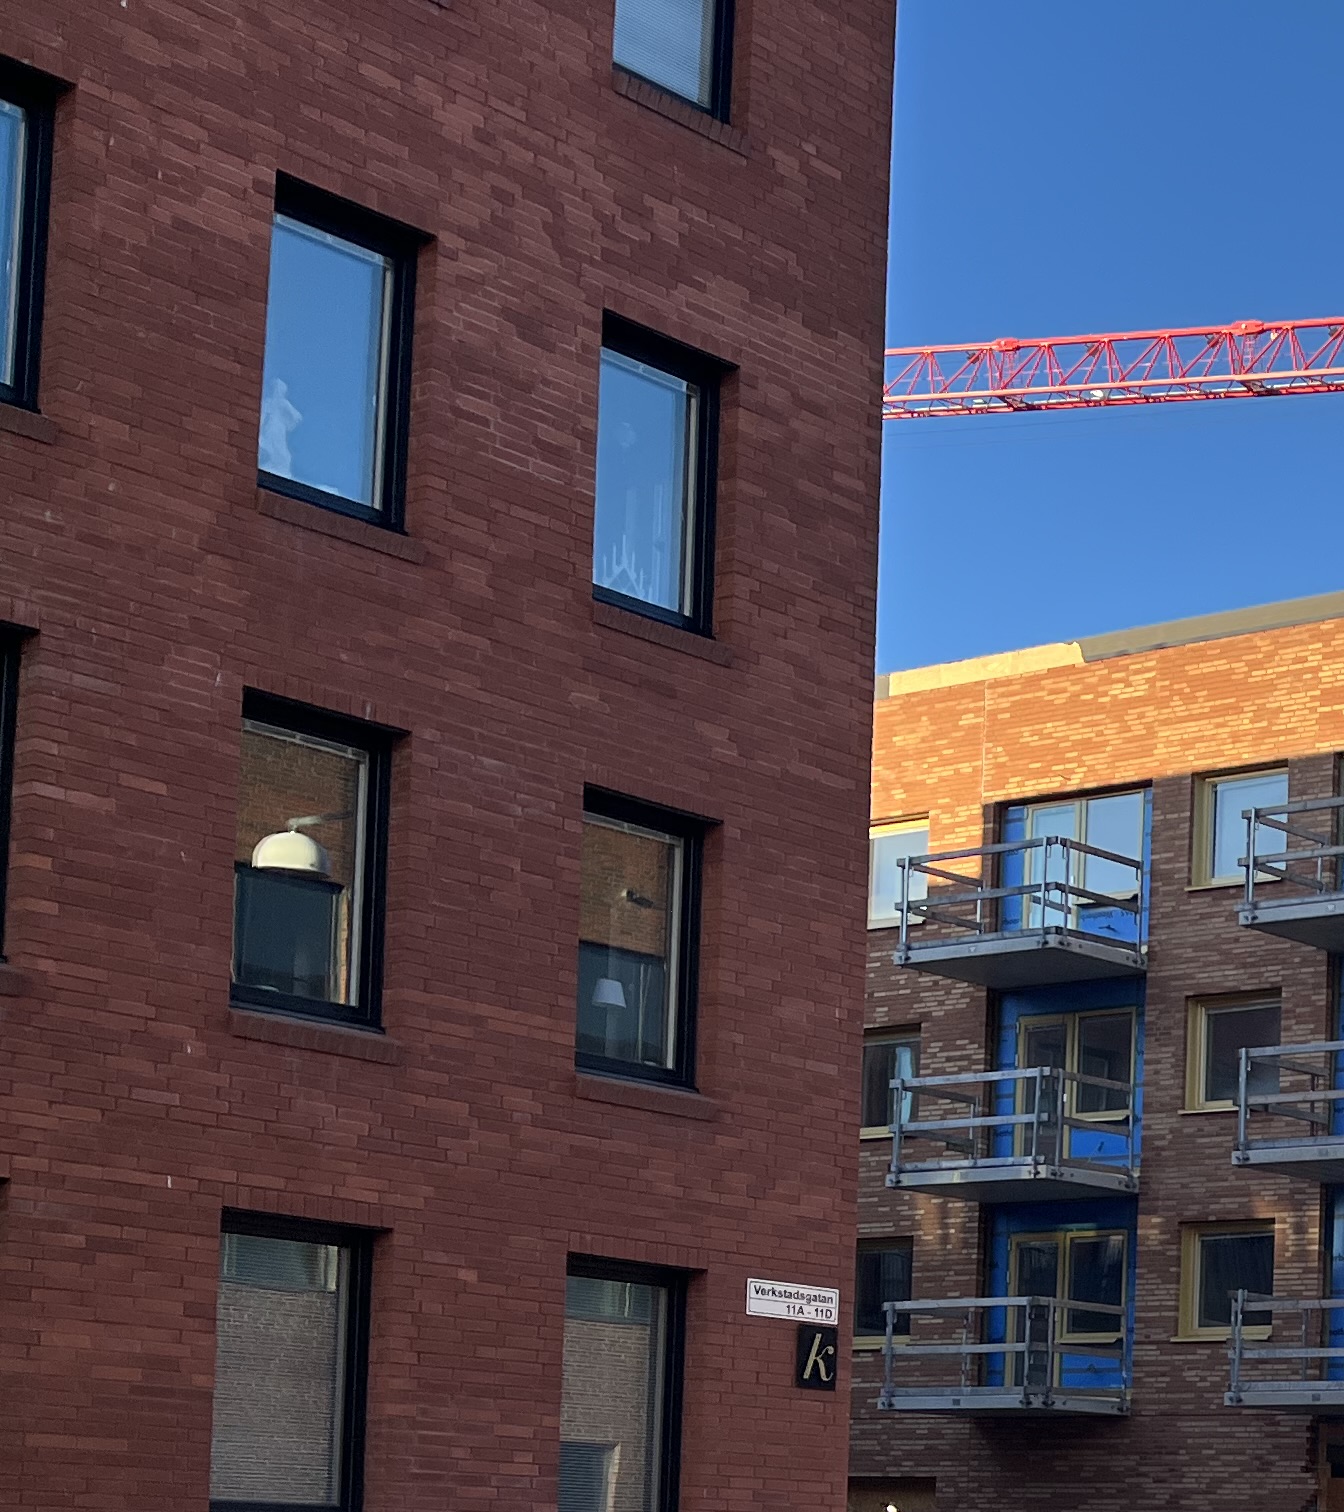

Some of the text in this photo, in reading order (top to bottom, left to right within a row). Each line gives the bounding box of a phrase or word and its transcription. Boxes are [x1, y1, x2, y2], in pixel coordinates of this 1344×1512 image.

[753, 1284, 834, 1305] Verkstadsgatan
[786, 1304, 805, 1316] 11A
[814, 1307, 833, 1319] 11D
